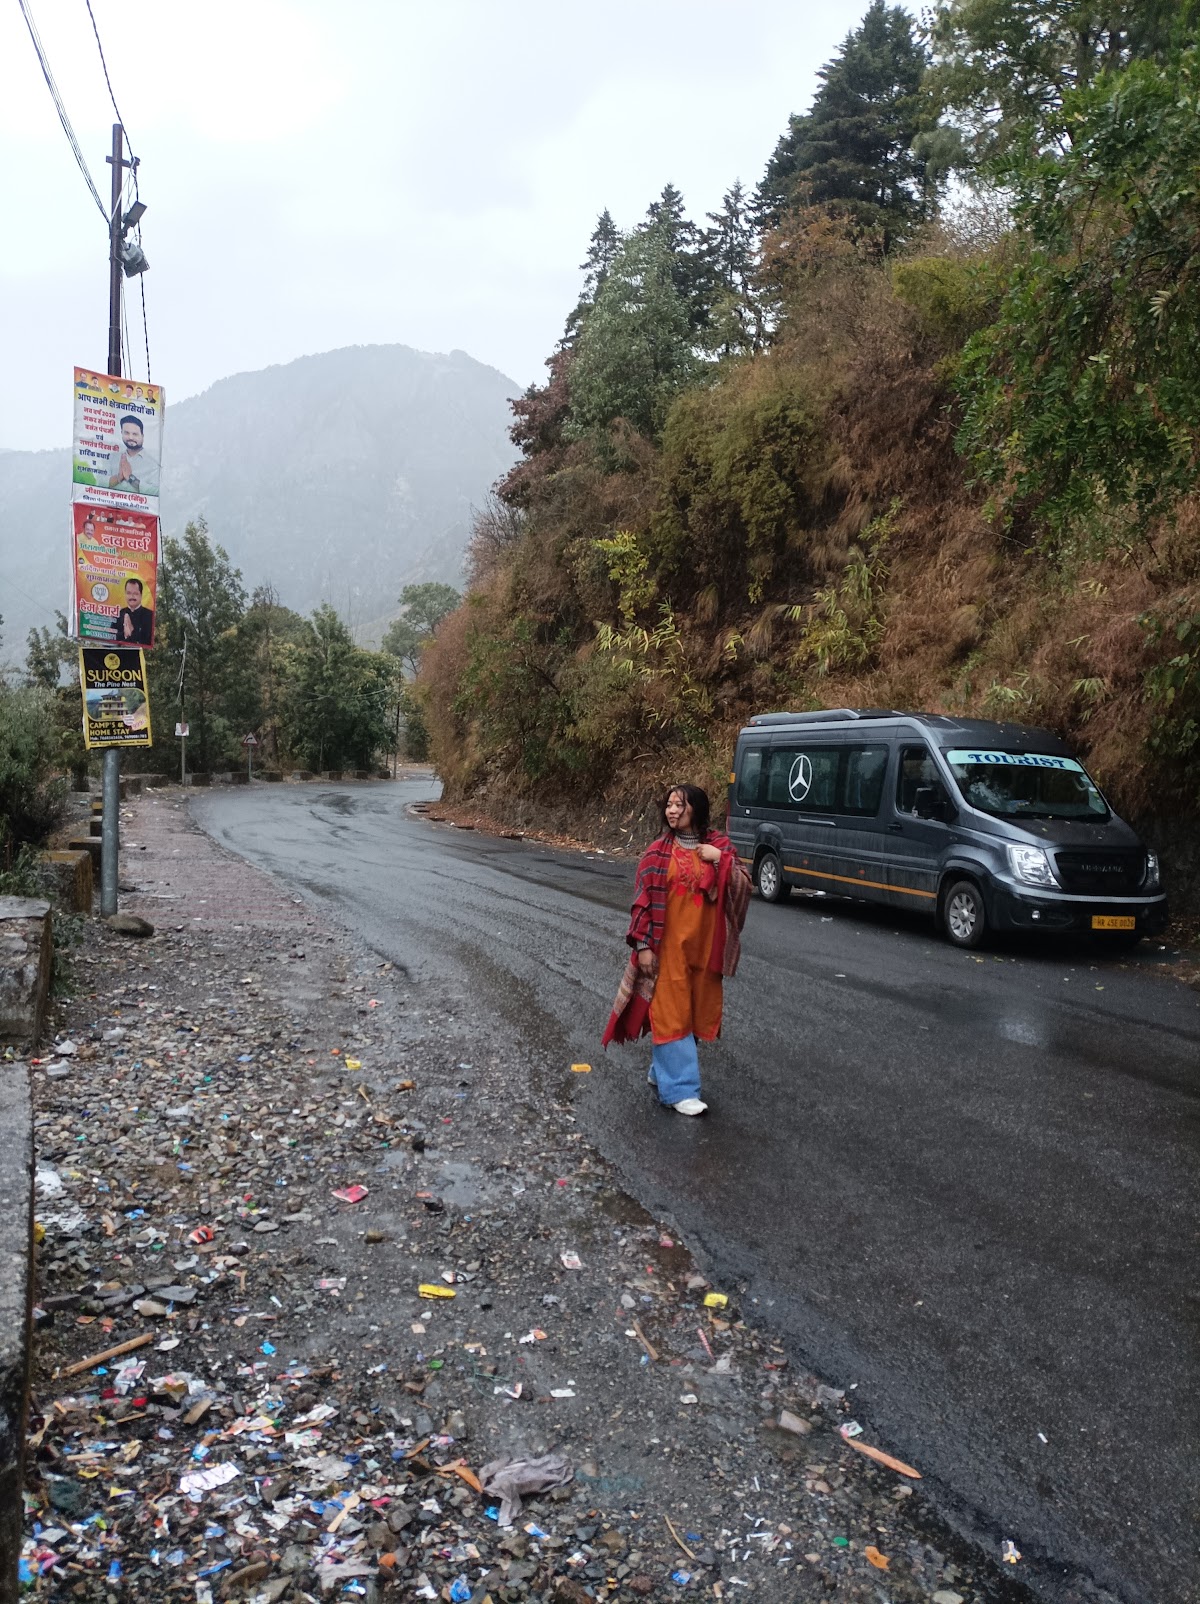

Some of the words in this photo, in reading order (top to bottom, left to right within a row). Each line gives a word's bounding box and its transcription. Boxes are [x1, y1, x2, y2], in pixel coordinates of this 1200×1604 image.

[78, 393, 91, 402] आप
[92, 396, 107, 406] सभी
[145, 406, 155, 416] को
[102, 535, 124, 547] नव
[127, 536, 150, 551] वर्ष
[80, 598, 96, 613] हेम
[98, 604, 120, 617] आर्य
[87, 669, 142, 682] SUKOON
[968, 754, 1066, 768] TOURIST
